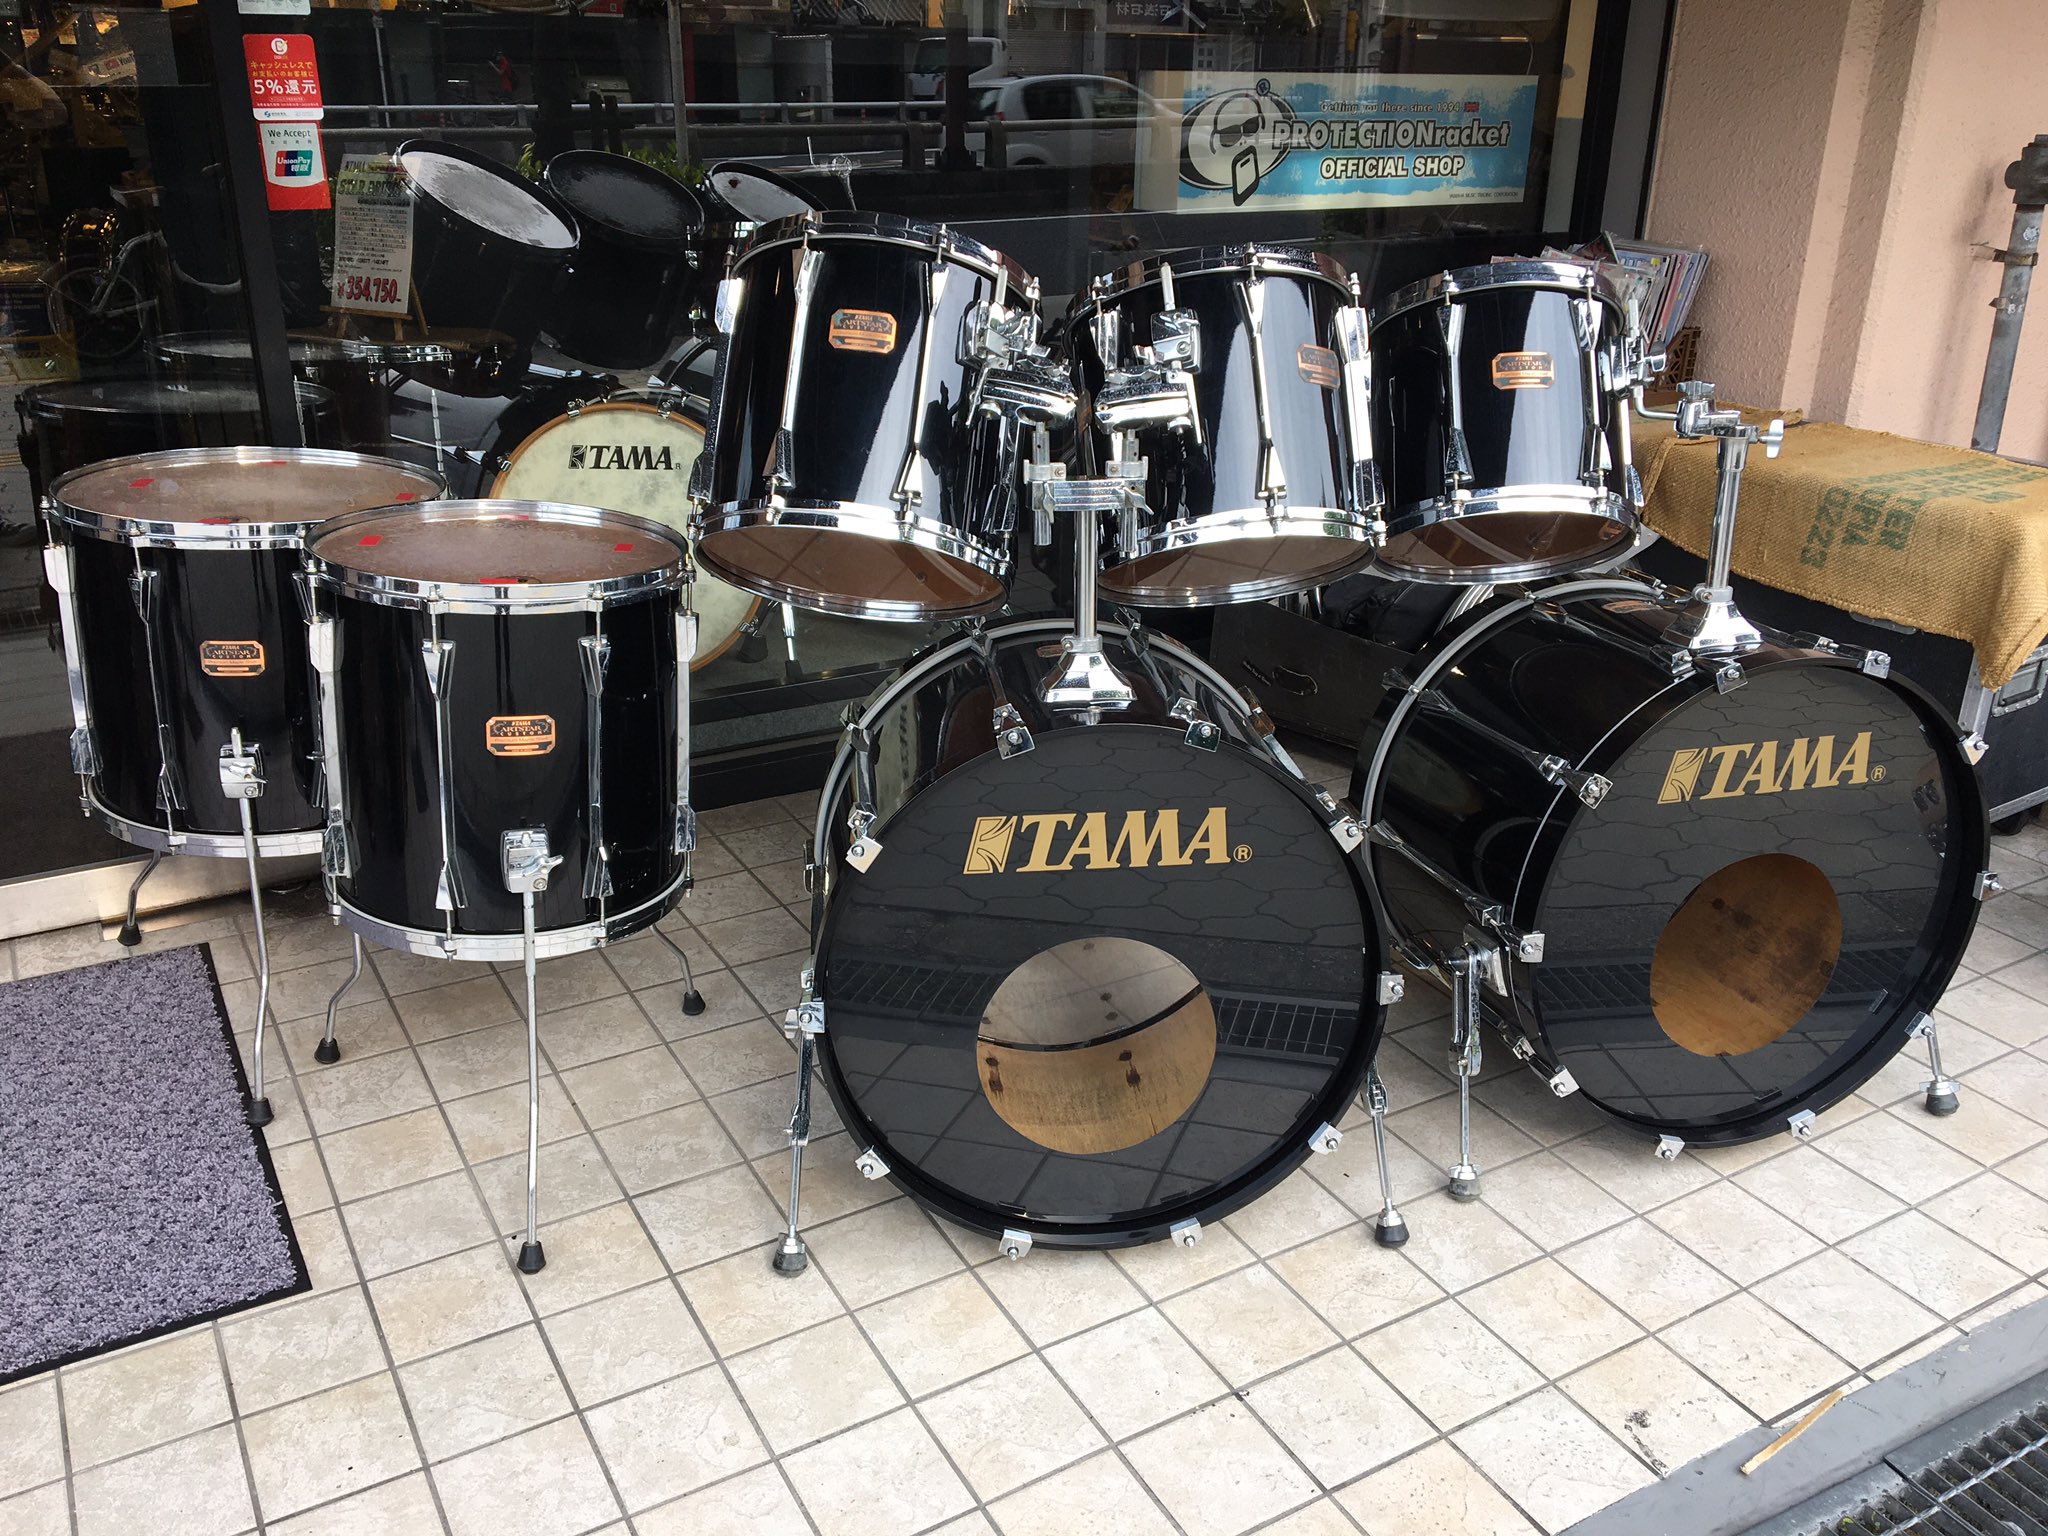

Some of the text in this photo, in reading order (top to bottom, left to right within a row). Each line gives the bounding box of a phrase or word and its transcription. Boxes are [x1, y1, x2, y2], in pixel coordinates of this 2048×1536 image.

[251, 61, 313, 69] キャッシュレスで
[254, 79, 317, 95] 5%還元
[1321, 101, 1460, 115] Getting you there since 1994
[268, 130, 311, 138] We Accept
[277, 157, 311, 168] UnionPay
[1321, 155, 1465, 179] OFFICIAL SHOP
[845, 320, 882, 328] ARTSTAR
[588, 446, 674, 470] TAMA
[1700, 731, 1873, 801] TAMA
[1015, 806, 1232, 873] TAMA
